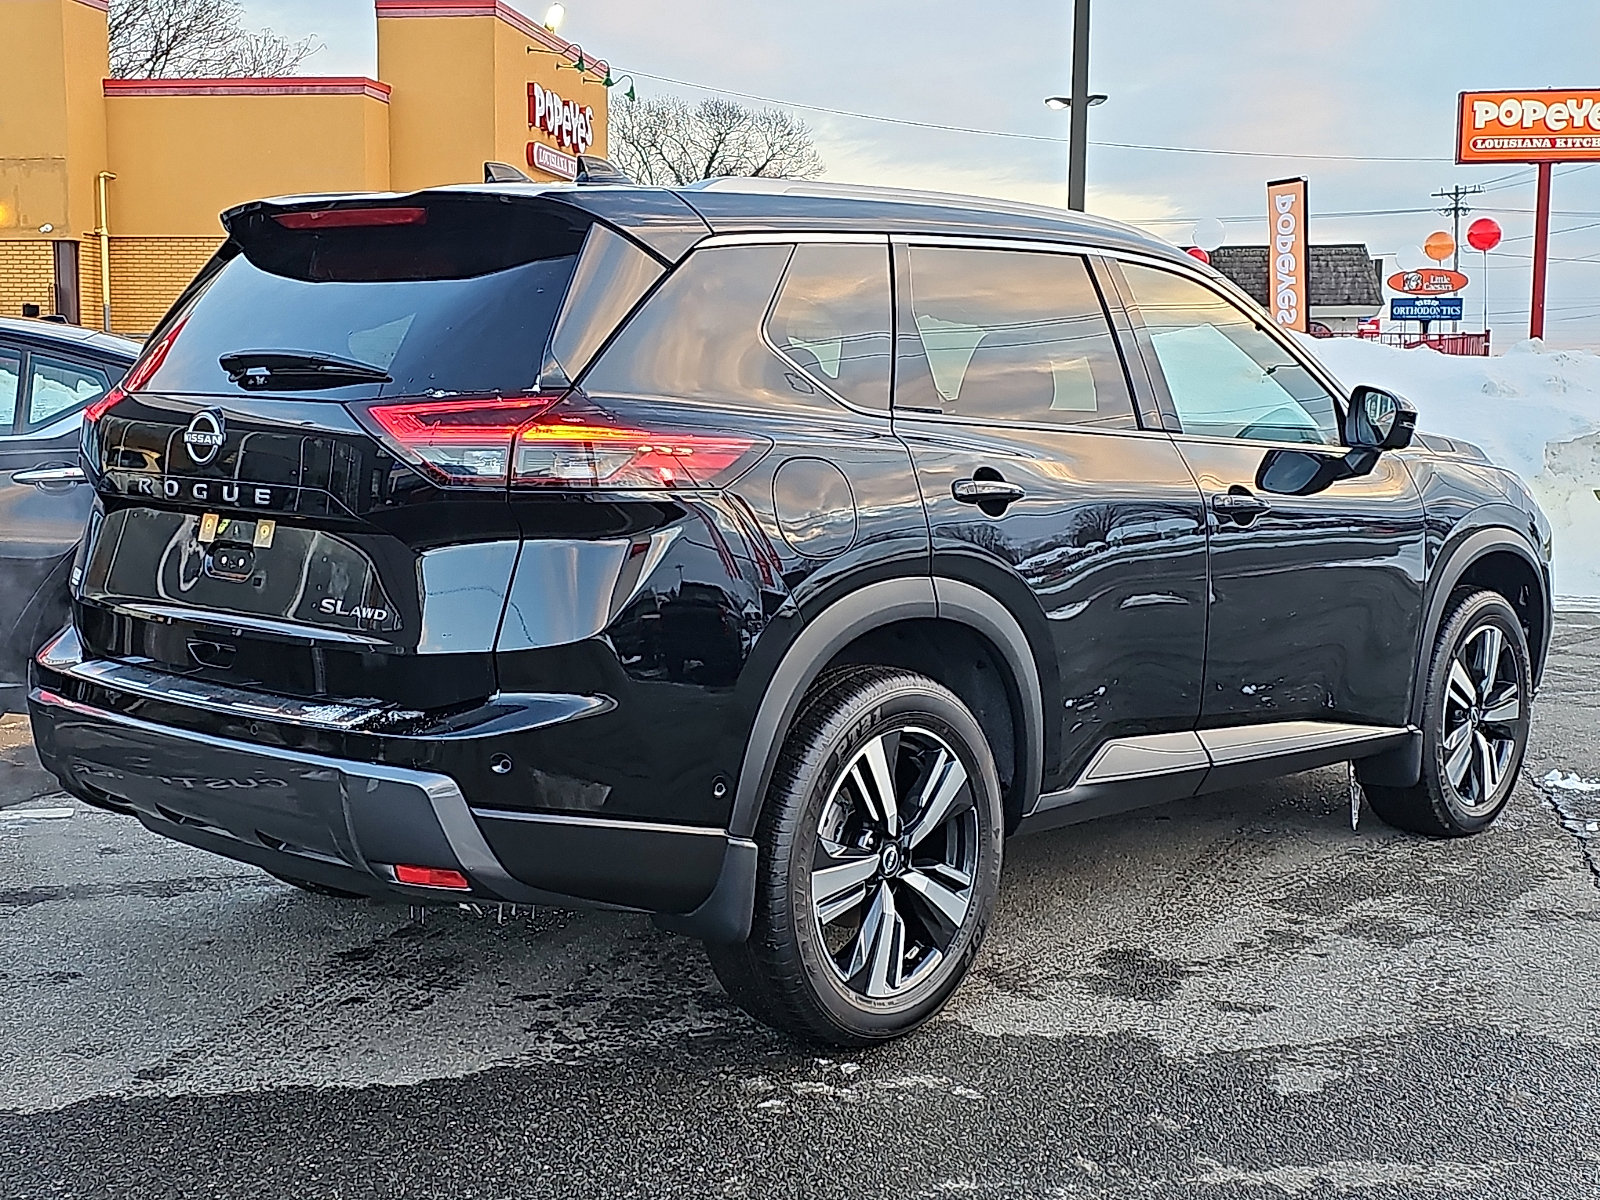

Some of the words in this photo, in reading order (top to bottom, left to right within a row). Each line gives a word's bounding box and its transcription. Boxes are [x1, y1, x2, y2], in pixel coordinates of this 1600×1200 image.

[1475, 138, 1551, 148] LOUISIANA
[1393, 306, 1461, 315] ORTHODONTICS
[185, 432, 222, 446] NISSAN
[138, 477, 272, 505] ROGUE
[319, 598, 349, 616] SL
[349, 606, 388, 621] AWD
